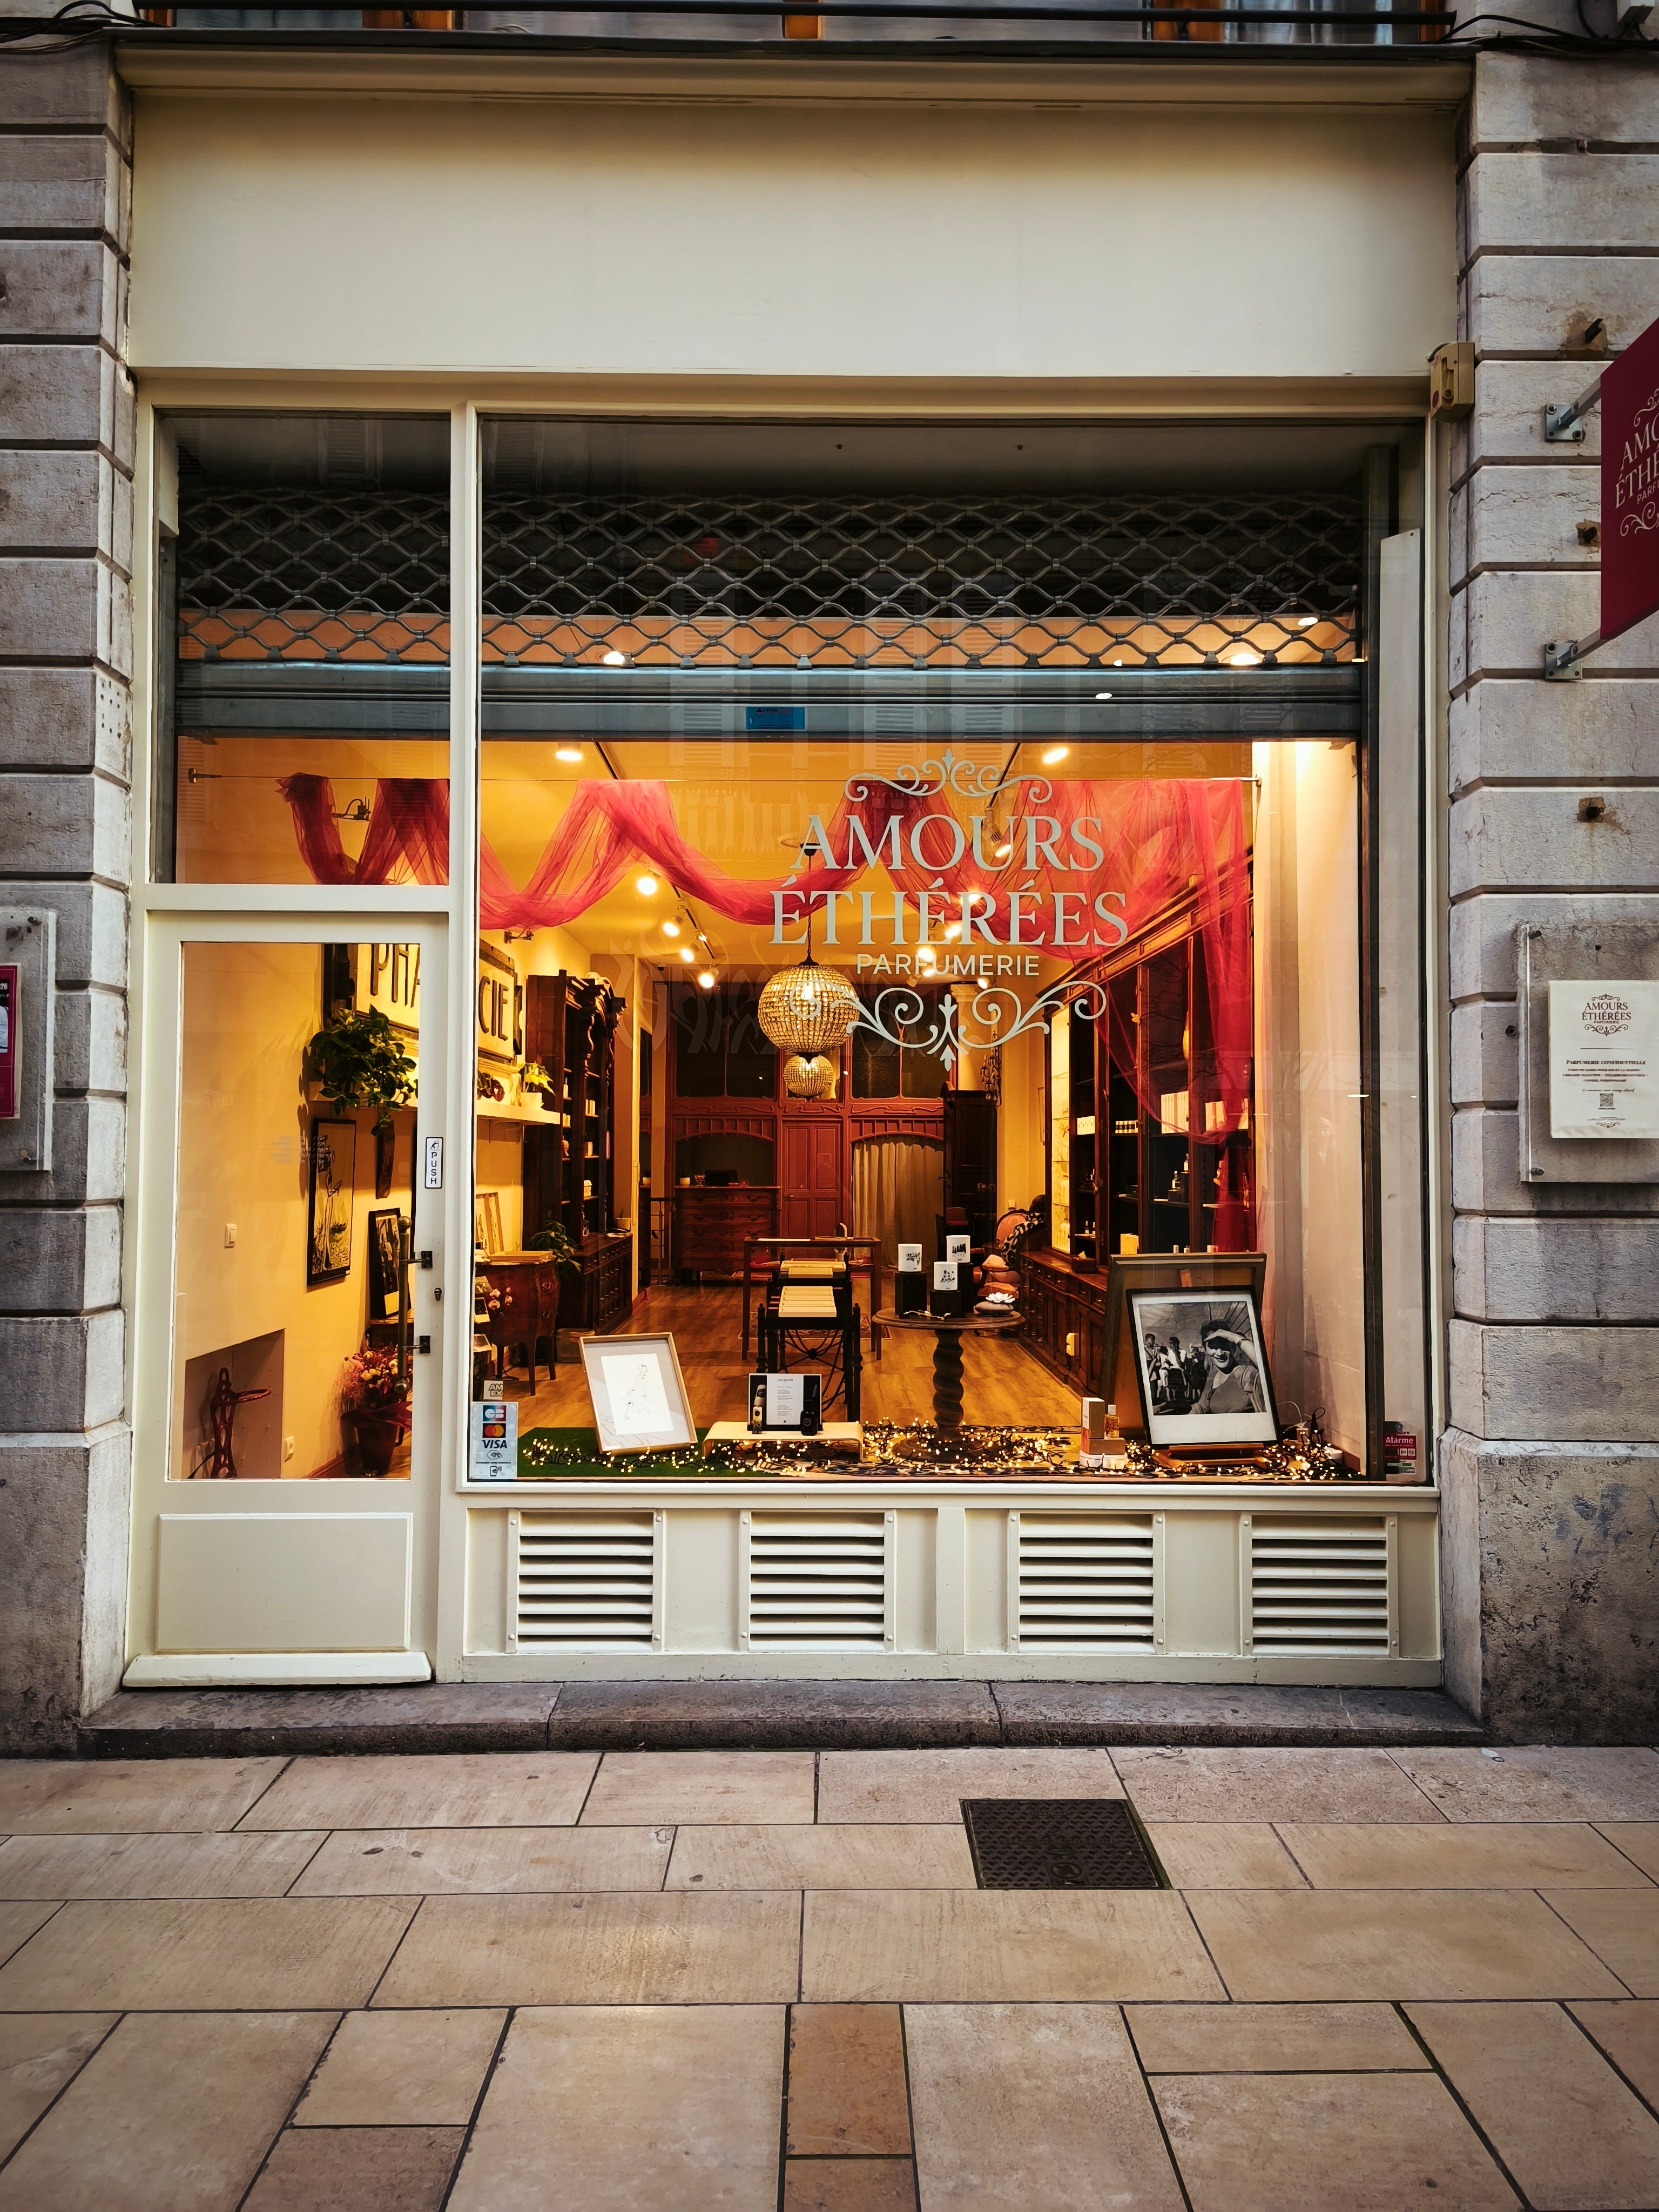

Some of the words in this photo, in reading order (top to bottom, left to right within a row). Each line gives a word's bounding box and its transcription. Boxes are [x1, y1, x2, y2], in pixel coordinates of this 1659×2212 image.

[1637, 482, 1659, 505] PARF
[789, 814, 1104, 871] AMOURS
[768, 877, 1128, 947] ÉTHÉRÉES
[856, 953, 1040, 976] PARFUMERIE
[1582, 1010, 1631, 1020] ÉTHÉRÉES
[481, 1439, 508, 1449] VISA
